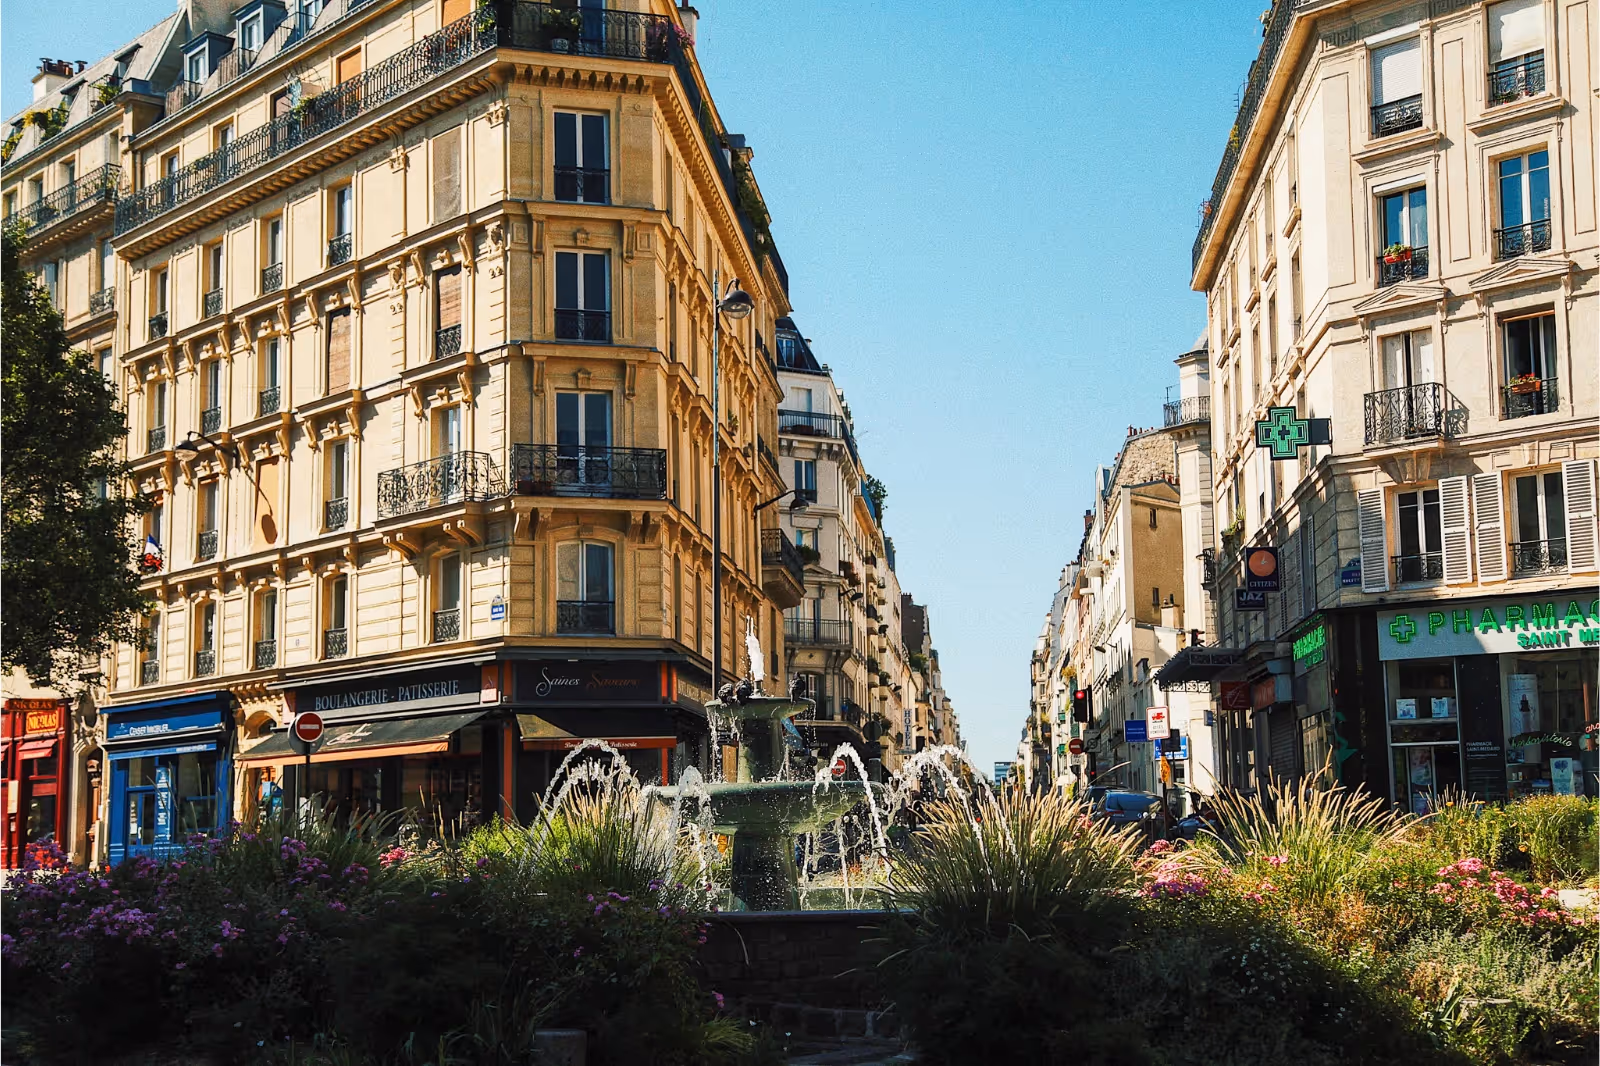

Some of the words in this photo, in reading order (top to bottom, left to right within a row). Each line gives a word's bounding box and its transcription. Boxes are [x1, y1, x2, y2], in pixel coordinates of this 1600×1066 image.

[1249, 580, 1278, 588] CITIZEN
[1239, 591, 1263, 601] JAZ
[1517, 630, 1569, 648] SAINT
[535, 667, 580, 697] Saines
[315, 689, 389, 711] BOULANGERIE
[398, 680, 460, 701] PATISSERIE
[29, 714, 56, 729] NICOLAS
[904, 710, 912, 747] HOTEL
